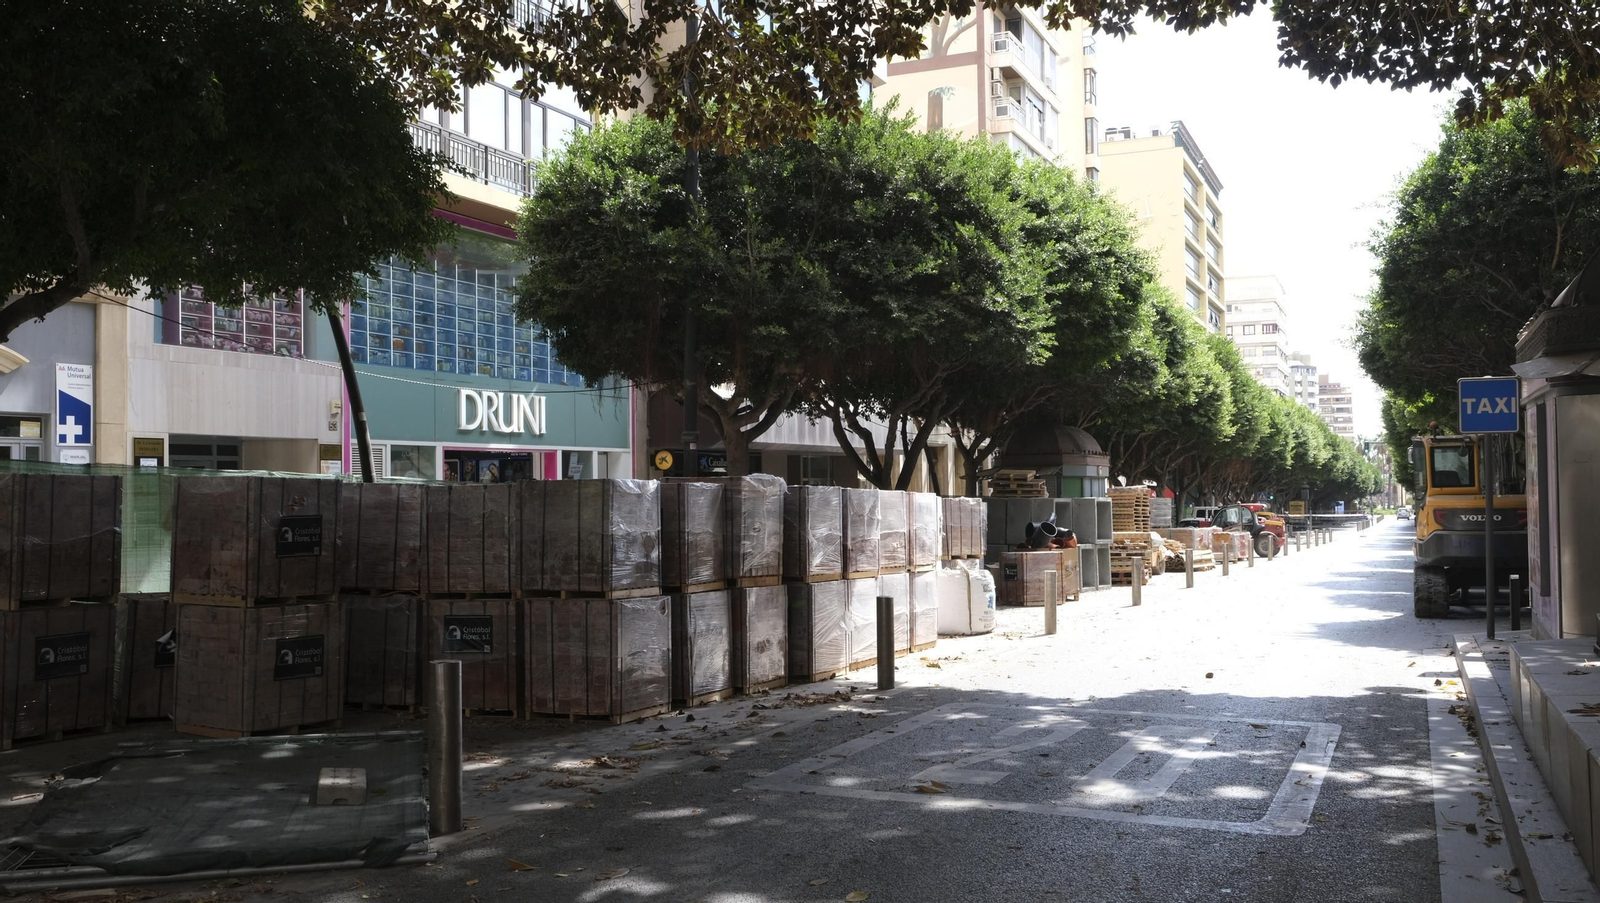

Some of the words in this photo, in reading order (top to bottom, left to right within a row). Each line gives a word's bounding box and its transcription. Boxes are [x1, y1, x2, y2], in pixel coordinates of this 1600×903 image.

[458, 388, 547, 435] DRUNI
[1462, 397, 1516, 414] TAXI
[910, 714, 1220, 802] 20
